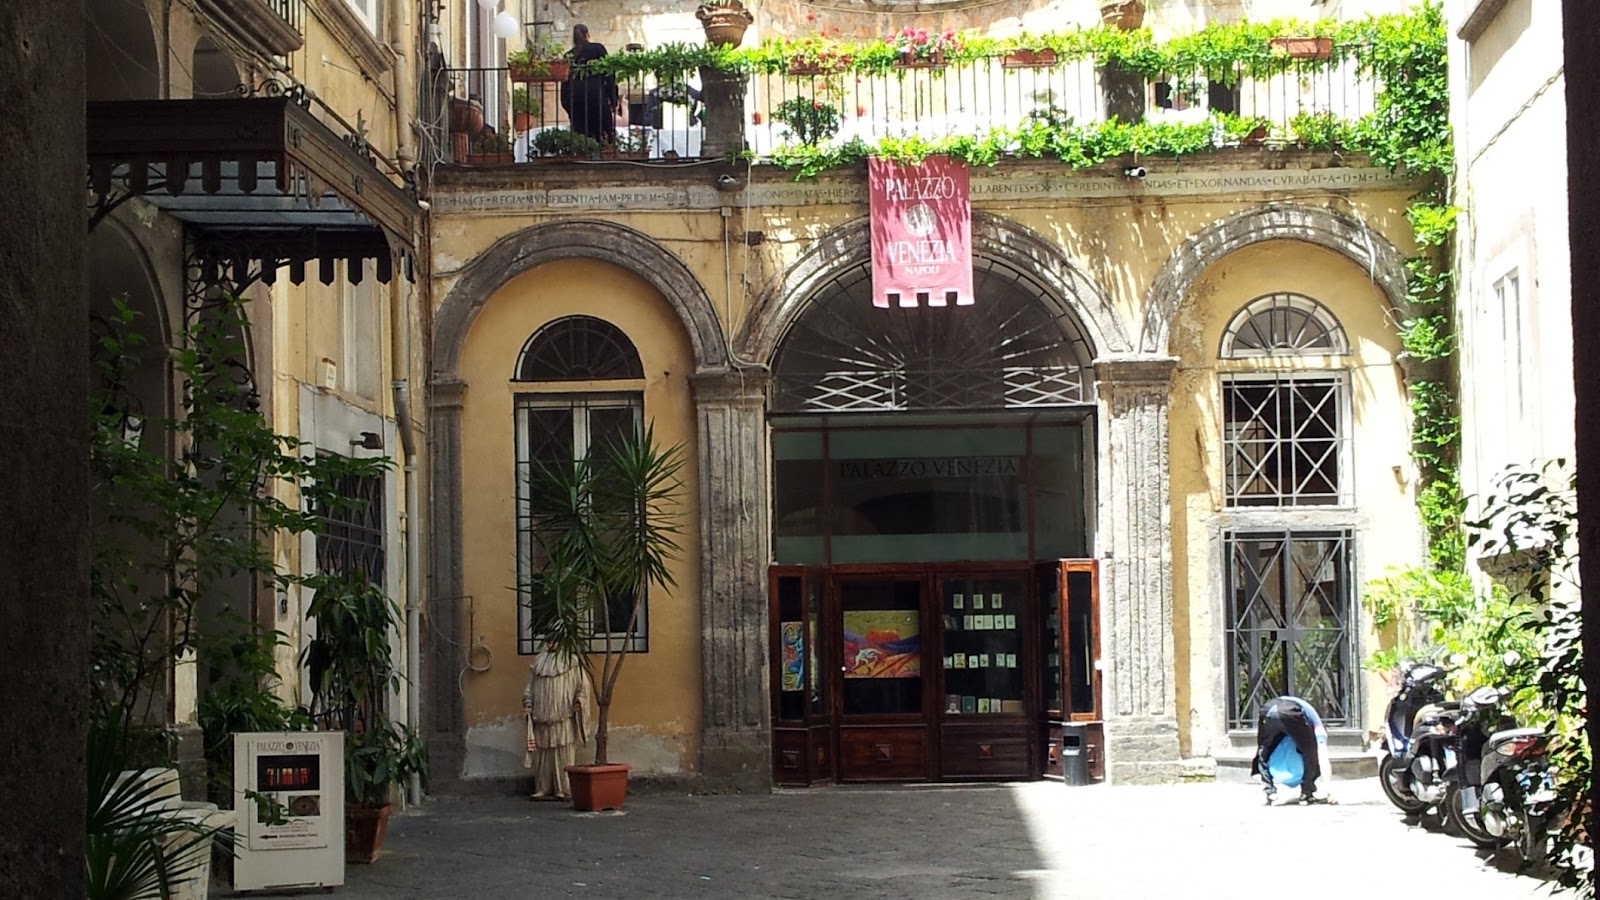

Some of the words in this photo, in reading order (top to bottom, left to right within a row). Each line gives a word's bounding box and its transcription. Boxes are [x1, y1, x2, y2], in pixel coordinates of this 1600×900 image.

[885, 176, 955, 200] PALAZZO
[1177, 178, 1189, 188] ET
[1194, 176, 1267, 188] EXORNANDAS
[1272, 174, 1322, 186] CVRABAT
[1358, 172, 1367, 182] M
[453, 196, 485, 206] HASCE
[493, 195, 523, 205] REGIA
[598, 194, 617, 203] IAM
[887, 239, 956, 264] VENEZIA
[904, 265, 940, 275] NAPOLI
[840, 461, 926, 479] PALAZZO
[932, 458, 1017, 476] VENEZIA
